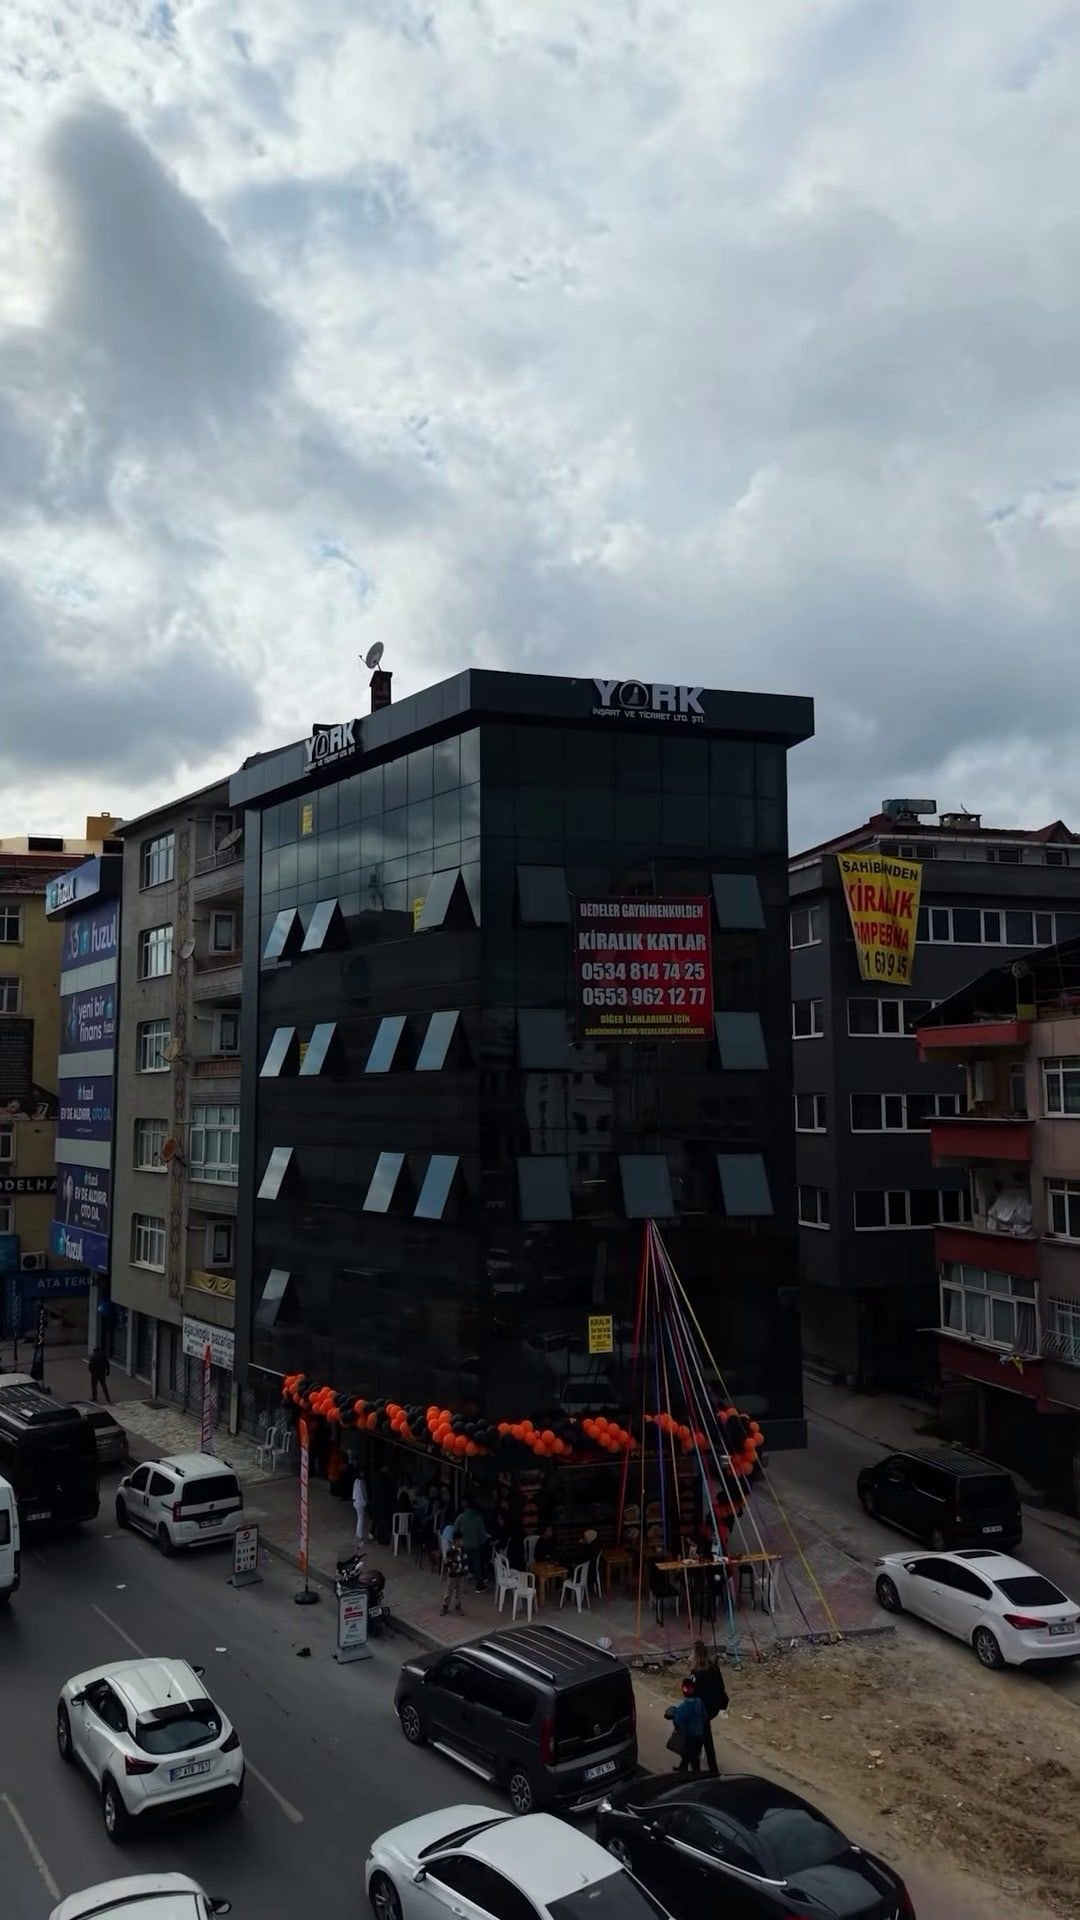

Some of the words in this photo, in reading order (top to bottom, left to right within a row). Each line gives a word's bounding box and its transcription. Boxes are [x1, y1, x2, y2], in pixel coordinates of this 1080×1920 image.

[592, 678, 705, 714] YORK
[624, 710, 636, 718] VE
[304, 719, 356, 763] YORK
[842, 858, 918, 881] SAHİBİNDEN
[846, 879, 916, 919] KİRALIK
[580, 903, 620, 918] DEDELER
[622, 902, 704, 918] GAYRİMENKULDEN
[578, 930, 644, 951] KİRALIK
[646, 932, 706, 951] KATLAR
[582, 962, 627, 980] 0534
[630, 962, 659, 980] 814
[662, 962, 681, 980] 74
[684, 962, 705, 980] 25
[582, 988, 628, 1006] 0553
[632, 988, 664, 1006] 962
[668, 988, 686, 1005] 12
[688, 988, 706, 1005] 77
[78, 998, 94, 1025] yeni
[94, 995, 106, 1016] bir
[80, 1022, 102, 1042] finans
[37, 1278, 60, 1288] ATA
